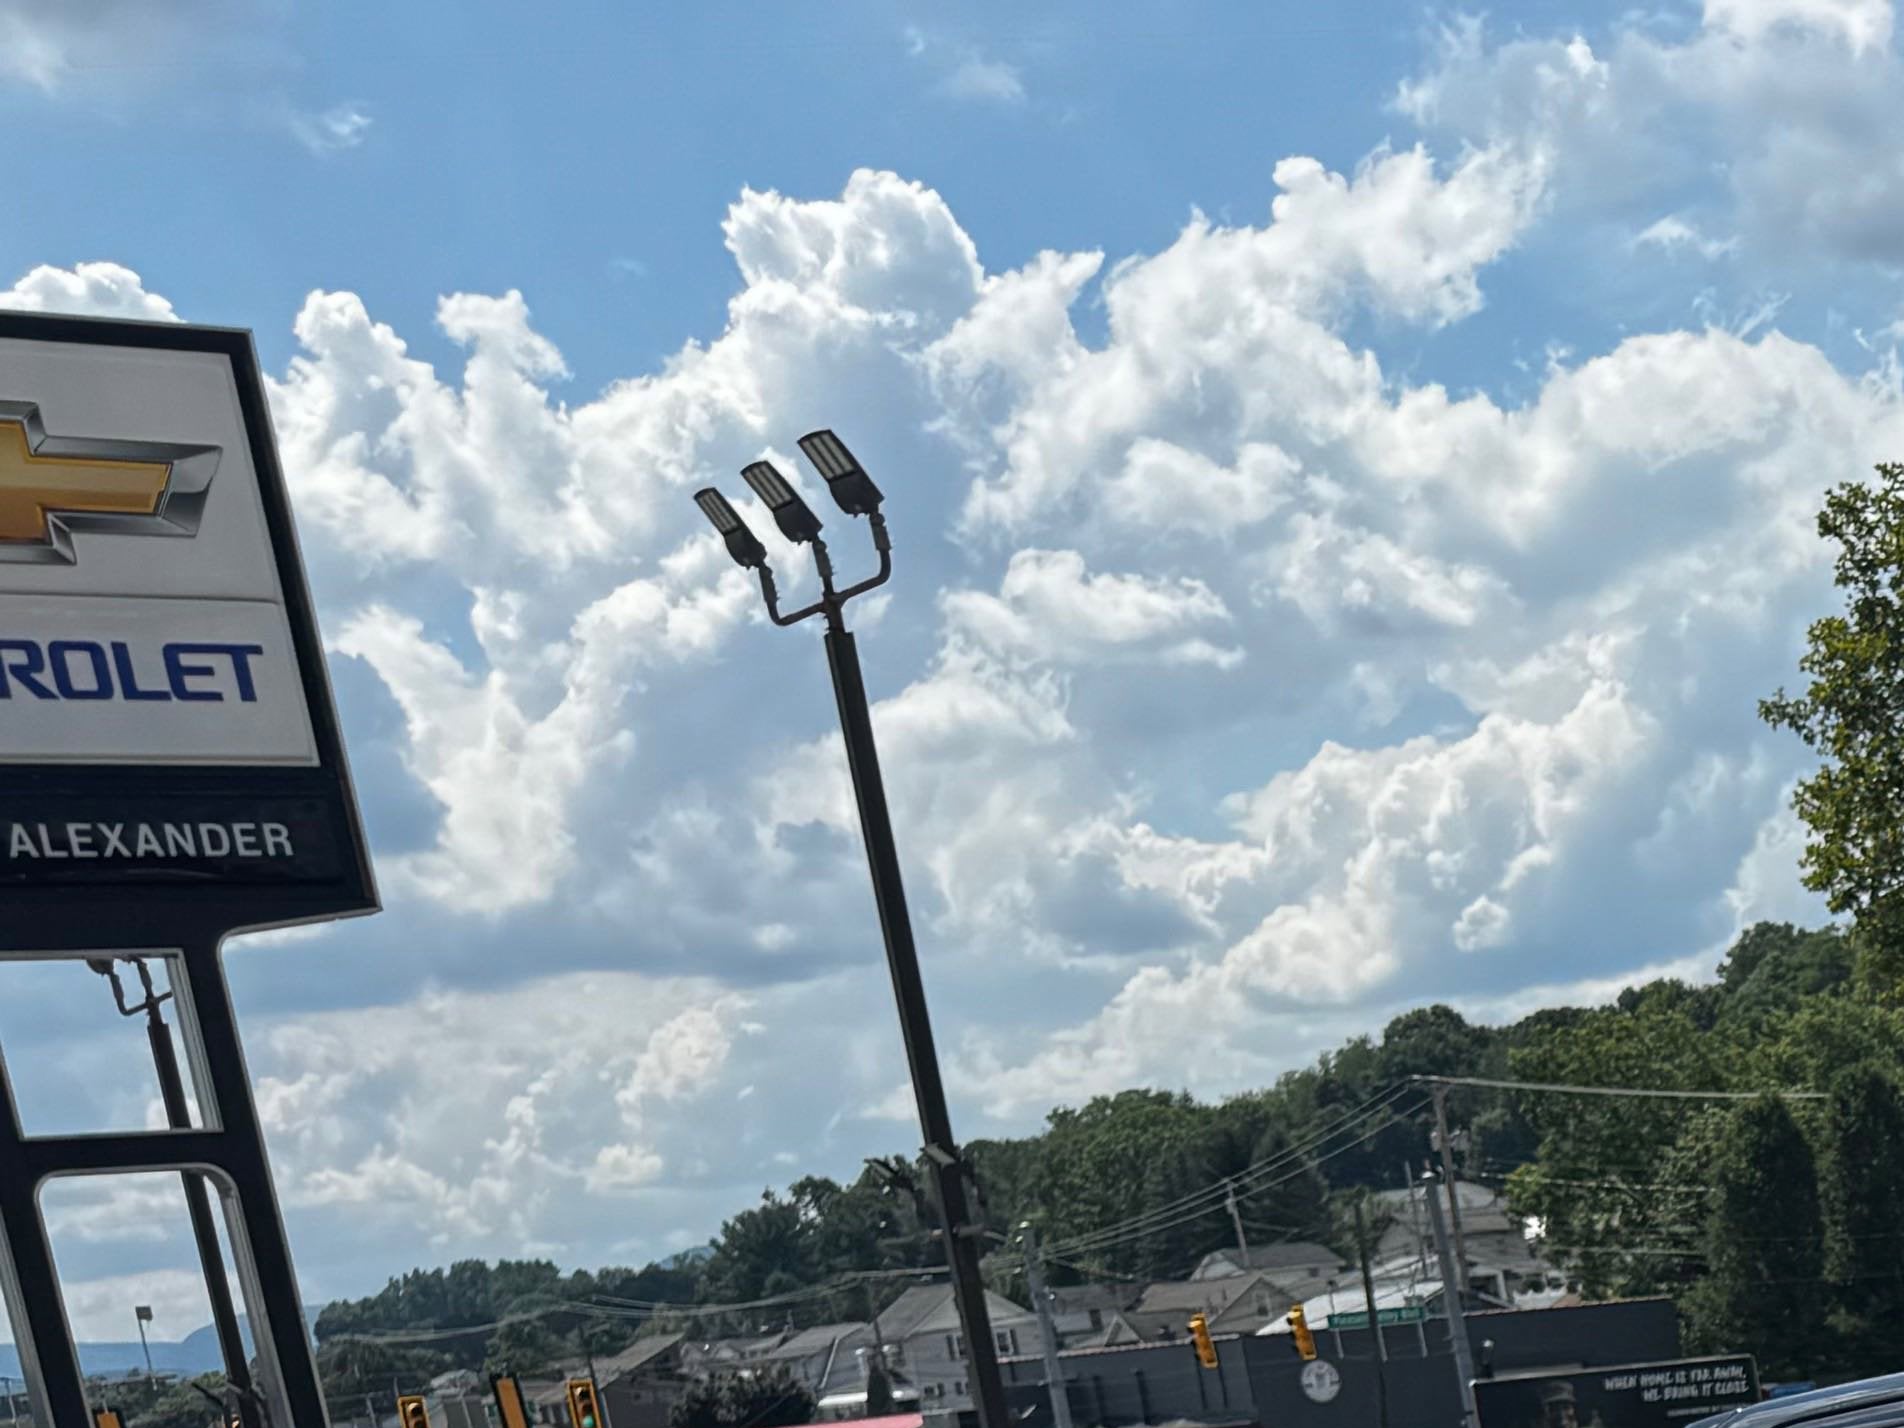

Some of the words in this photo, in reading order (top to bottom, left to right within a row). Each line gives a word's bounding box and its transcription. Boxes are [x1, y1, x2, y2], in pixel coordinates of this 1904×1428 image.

[9, 822, 294, 858] ALEXANDER
[1605, 1376, 1637, 1391] WHEN
[1676, 1370, 1688, 1384] IS
[1702, 1382, 1714, 1396] IT
